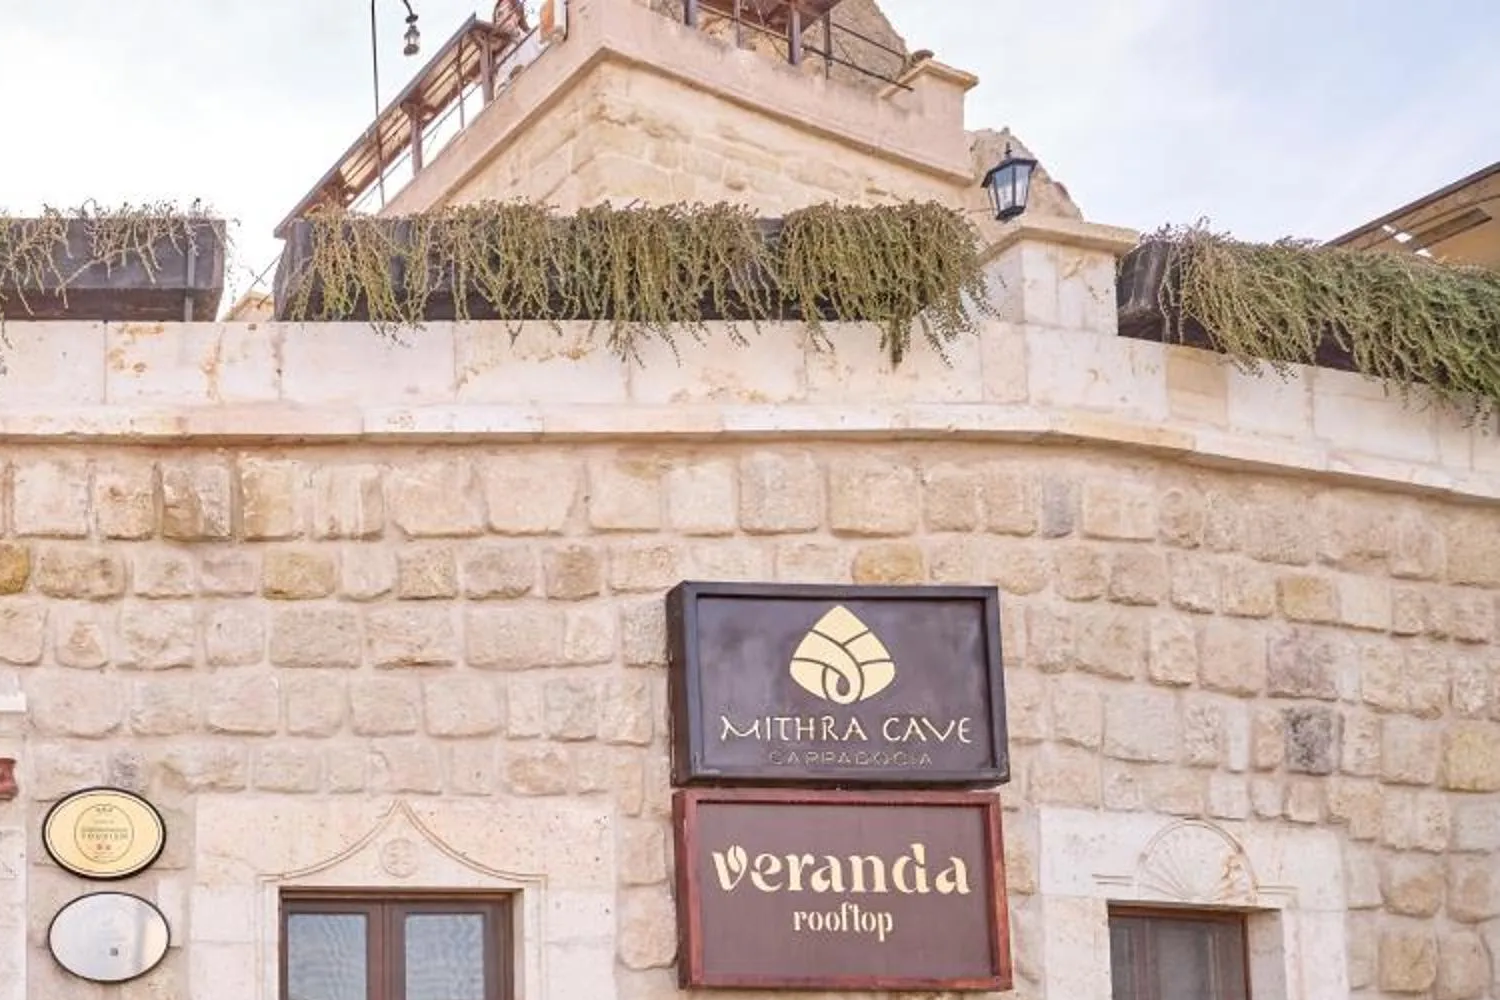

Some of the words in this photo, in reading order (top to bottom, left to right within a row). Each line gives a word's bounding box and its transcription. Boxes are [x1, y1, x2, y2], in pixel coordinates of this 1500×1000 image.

[721, 715, 868, 742] MITHRA
[883, 716, 973, 743] CAVE
[794, 902, 893, 942] rooftop
